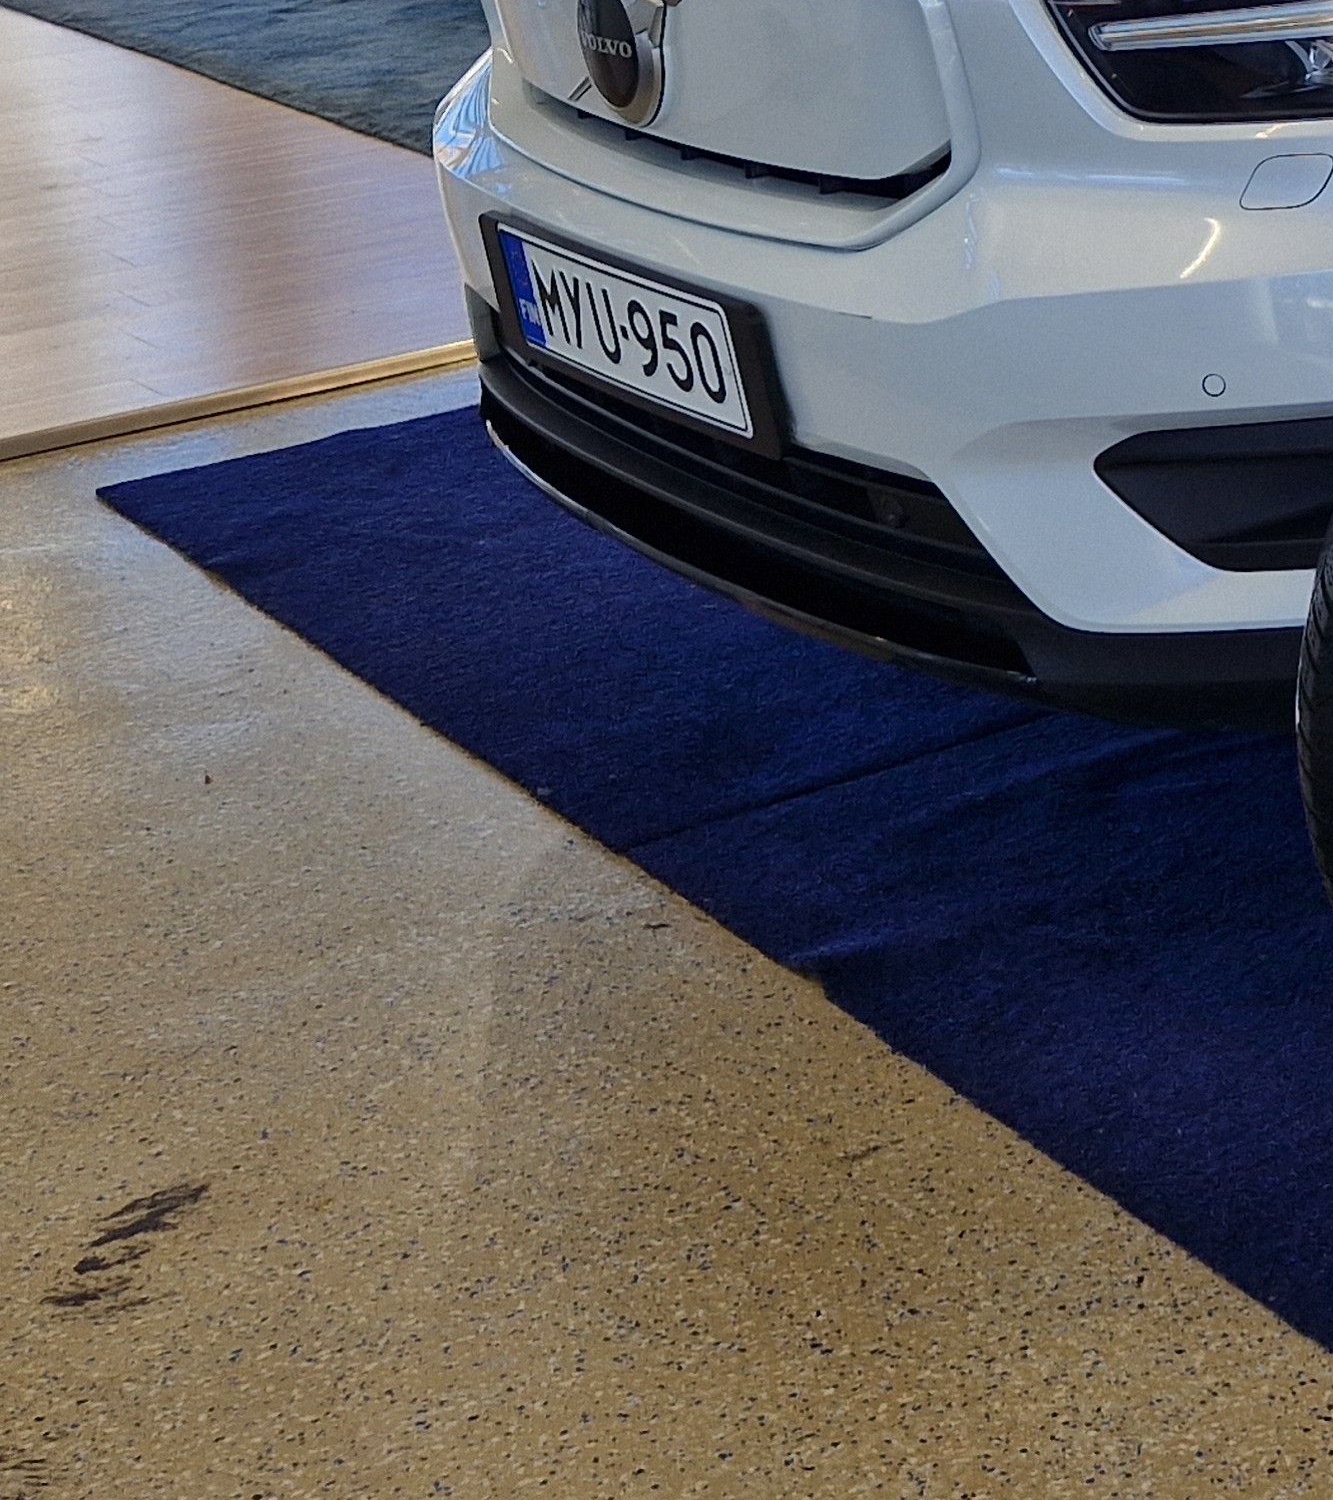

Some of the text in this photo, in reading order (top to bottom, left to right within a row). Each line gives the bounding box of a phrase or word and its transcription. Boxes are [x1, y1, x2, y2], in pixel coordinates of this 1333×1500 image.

[581, 31, 633, 58] VOLVO
[519, 297, 541, 325] FIN
[532, 259, 727, 404] MYU-950
